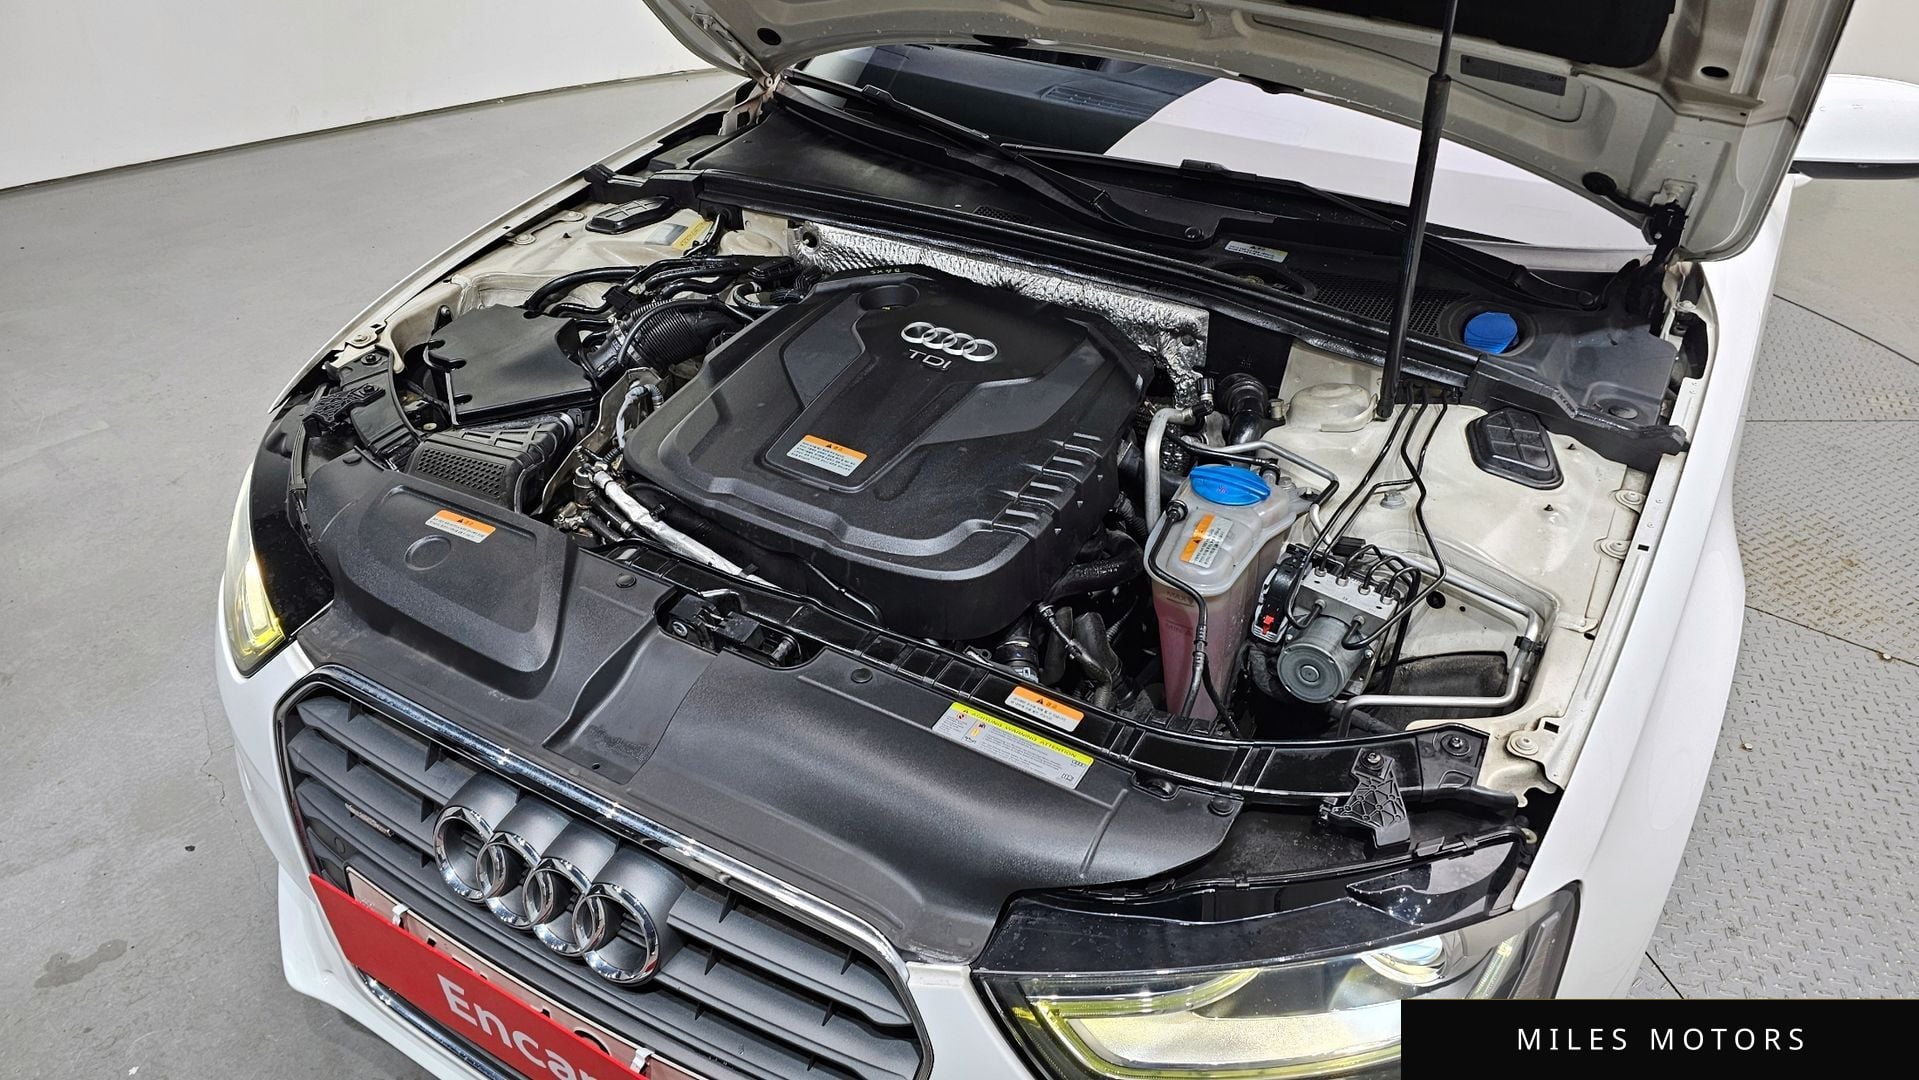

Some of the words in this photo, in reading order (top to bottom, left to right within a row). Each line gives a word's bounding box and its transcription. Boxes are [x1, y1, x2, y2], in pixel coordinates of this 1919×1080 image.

[908, 348, 952, 369] TDI
[1005, 725, 1038, 742] WARNING
[1039, 739, 1077, 758] ATTENTION
